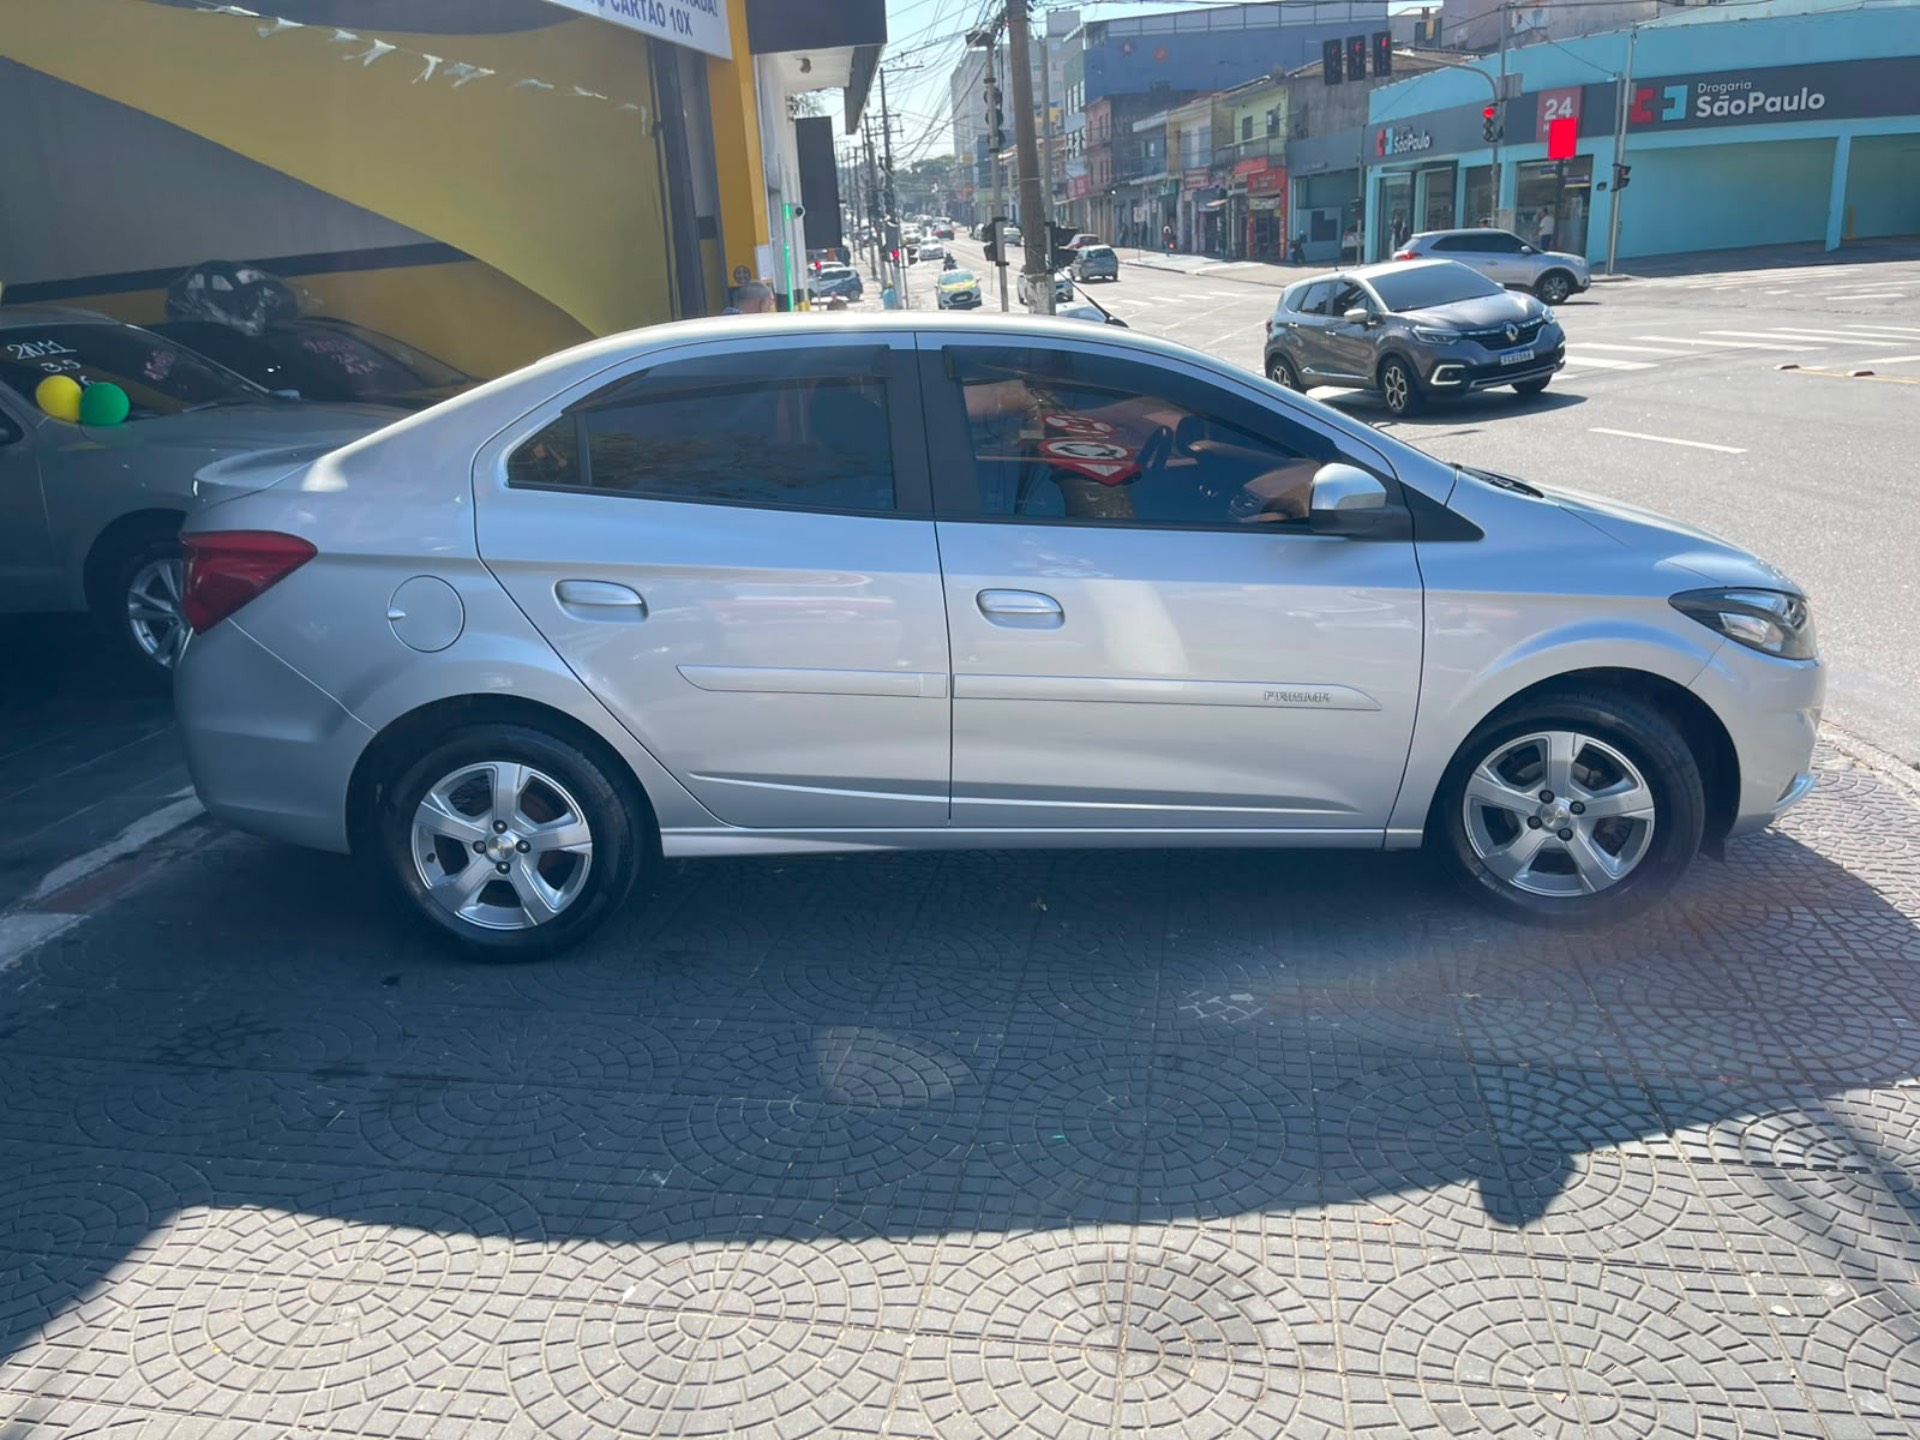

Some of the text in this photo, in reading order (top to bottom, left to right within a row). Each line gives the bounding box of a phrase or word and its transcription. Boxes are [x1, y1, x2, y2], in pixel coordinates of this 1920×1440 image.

[670, 9, 693, 36] 10X
[1697, 81, 1752, 94] Drogaria
[1544, 97, 1572, 120] 24
